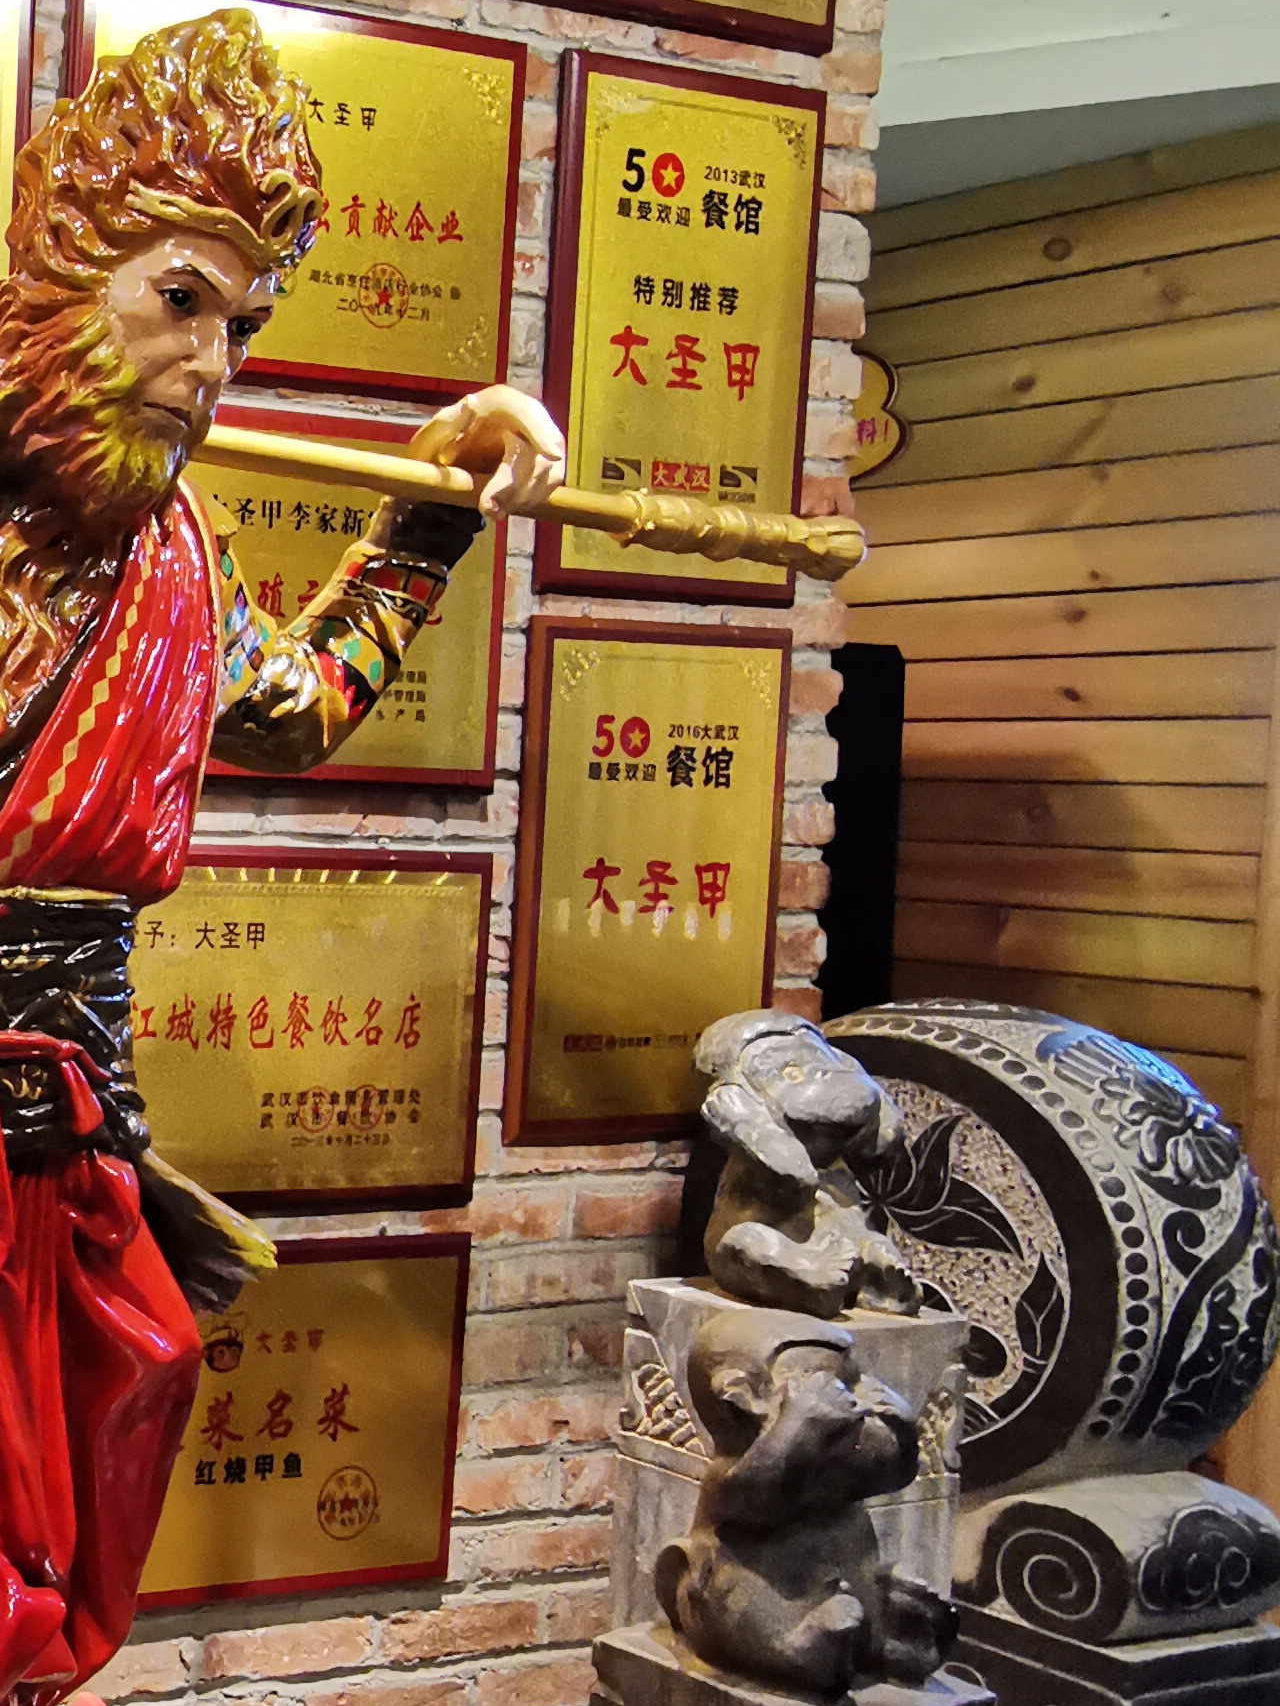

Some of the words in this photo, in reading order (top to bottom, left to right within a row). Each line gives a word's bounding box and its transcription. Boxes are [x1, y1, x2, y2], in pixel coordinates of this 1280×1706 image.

[307, 97, 378, 131] 大圣甲
[704, 166, 766, 189] 2013武汉
[617, 197, 690, 227] 最受欢迎
[701, 189, 763, 236] 餐馆
[633, 274, 739, 317] 特别推荐
[609, 325, 760, 401] 大圣甲
[214, 493, 375, 538] 圣甲李家新
[668, 724, 739, 741] 2016大武汉
[666, 745, 734, 788] 餐馆
[583, 856, 731, 919] 大圣甲
[194, 1452, 303, 1486] 红烧甲鱼
